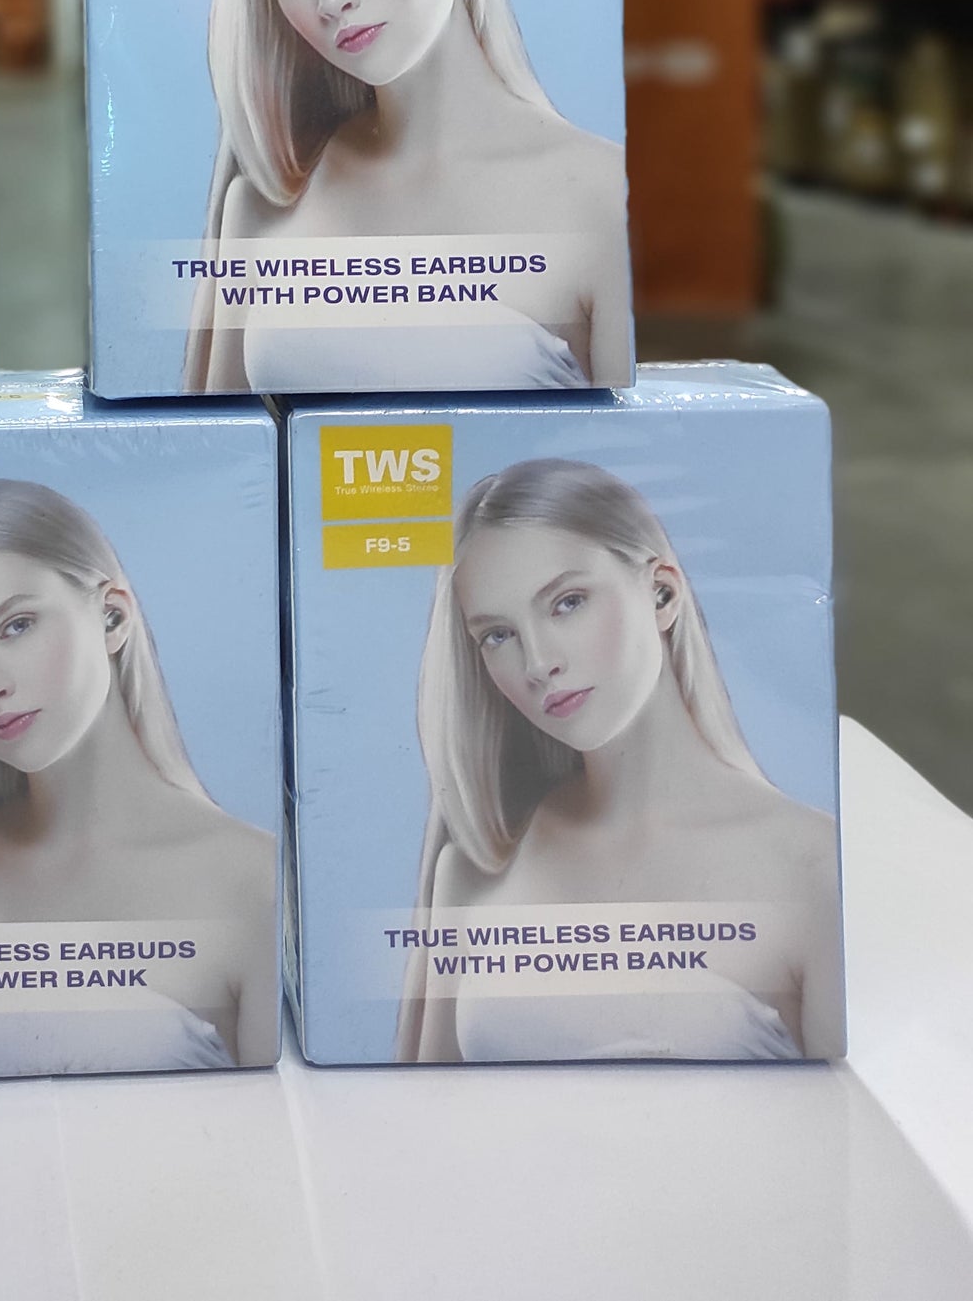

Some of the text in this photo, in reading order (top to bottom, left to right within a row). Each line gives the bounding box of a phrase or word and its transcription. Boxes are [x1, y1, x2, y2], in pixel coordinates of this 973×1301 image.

[172, 254, 547, 278] TRUE WIRELESS EARBUDS
[221, 283, 499, 306] WITH POWER BANK
[334, 448, 441, 485] TWS
[335, 483, 439, 496] True Wireless Stereo
[365, 536, 411, 554] F9-5
[384, 922, 757, 948] TRUE WIRELESS EARBUDS
[60, 940, 197, 961] EARBUDS
[433, 950, 708, 975] WITH POWER BANK
[66, 968, 148, 988] BANK
